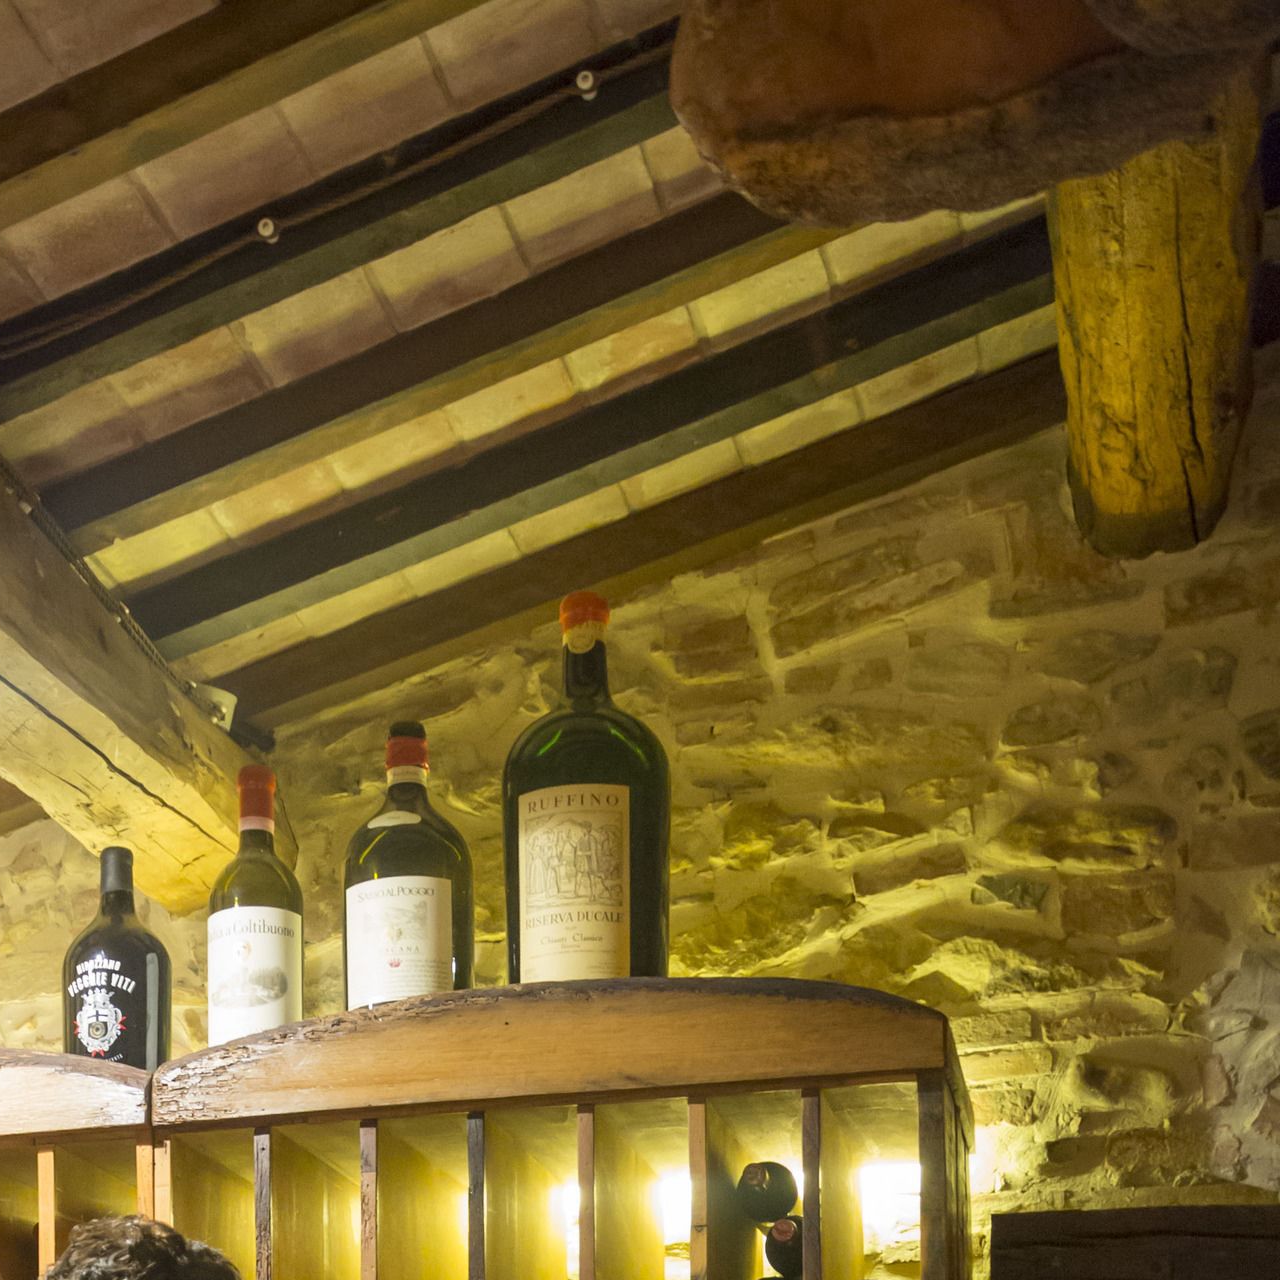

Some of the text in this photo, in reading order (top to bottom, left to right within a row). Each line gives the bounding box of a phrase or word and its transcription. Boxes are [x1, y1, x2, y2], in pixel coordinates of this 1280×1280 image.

[527, 792, 620, 814] RUFFINO
[525, 911, 624, 930] RISERVA DUCALE
[68, 971, 108, 998] VECCHIE
